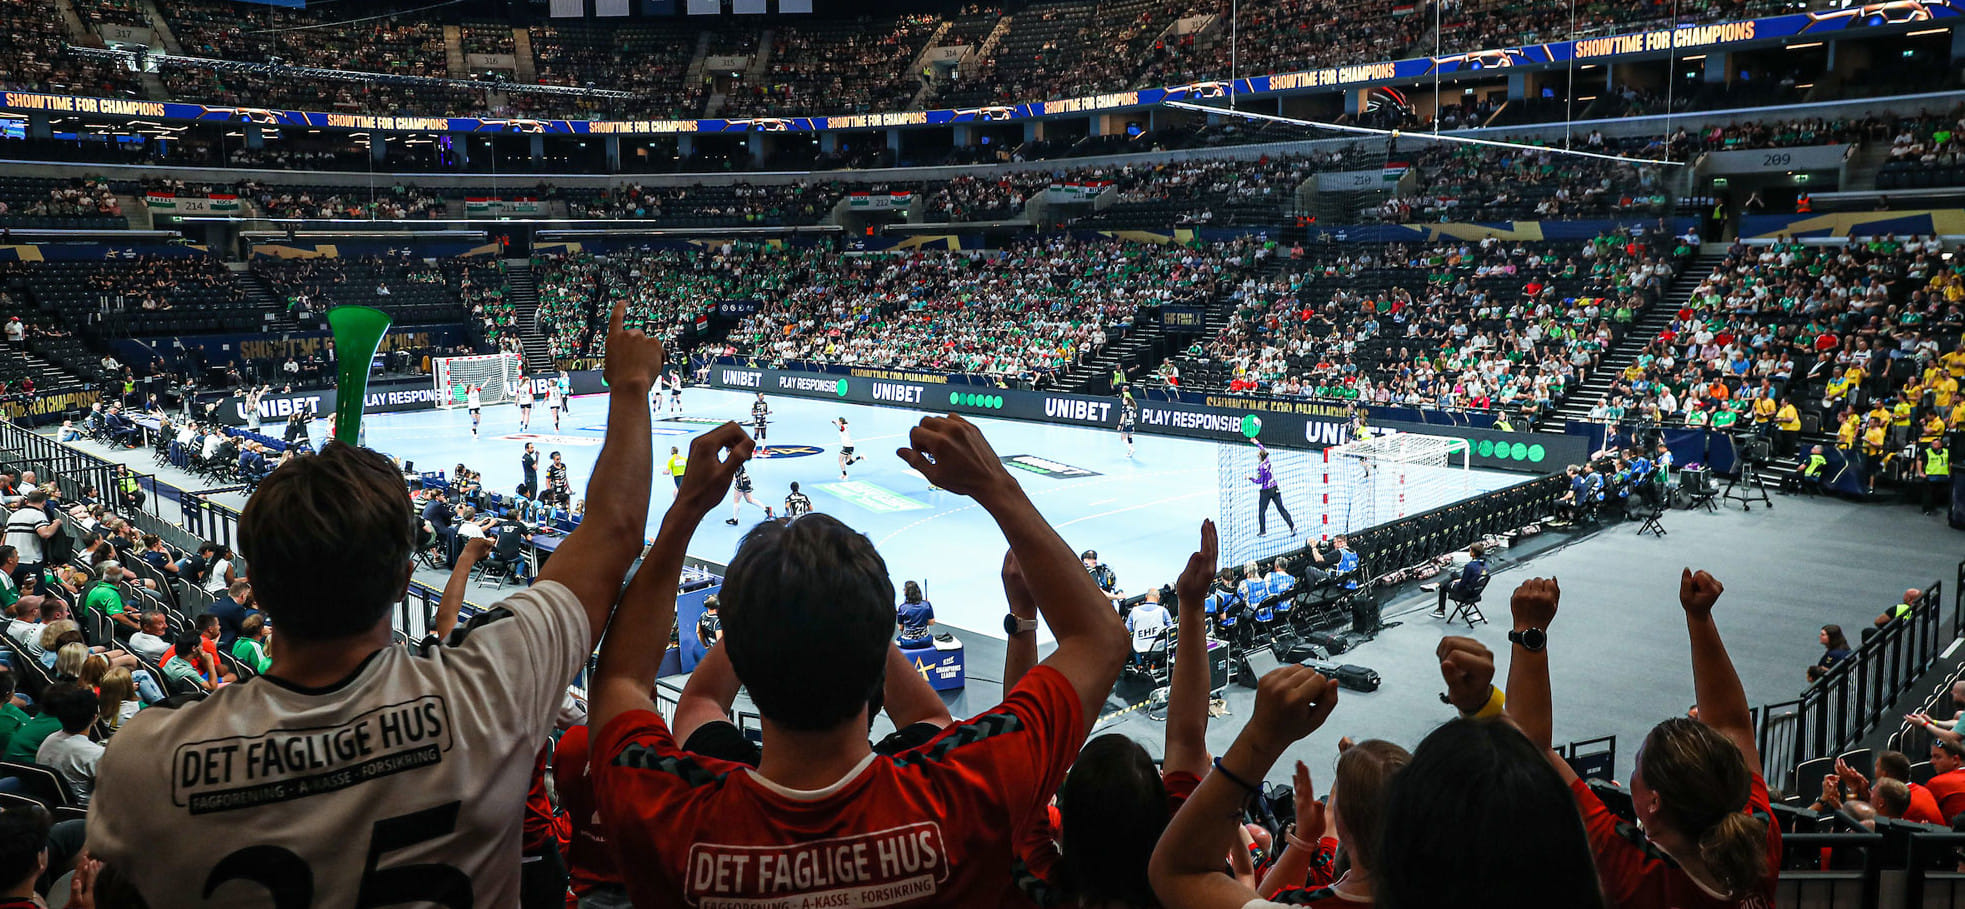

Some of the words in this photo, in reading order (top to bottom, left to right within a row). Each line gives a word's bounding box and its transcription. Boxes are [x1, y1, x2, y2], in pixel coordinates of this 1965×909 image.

[115, 29, 132, 38] 317
[1575, 33, 1643, 58] SHOWTIME
[1645, 30, 1671, 51] FOR
[1673, 21, 1756, 48] CHAMPIONS
[1268, 71, 1318, 90] SHOWTIME
[1319, 68, 1337, 86] FOR
[1338, 62, 1396, 83] CHAMPIONS
[5, 92, 74, 111] SHOWTIME
[75, 97, 98, 113] FOR
[99, 99, 165, 117] CHAMPIONS
[1044, 98, 1081, 114] SHOWTIME
[1081, 96, 1095, 111] FOR
[1096, 91, 1139, 109] CHAMPIONS
[327, 114, 376, 128] SHOWTIME
[377, 117, 394, 130] FOR
[395, 118, 449, 131] CHAMPIONS
[588, 120, 634, 134] SHOWTIME
[634, 121, 650, 133] FOR
[651, 120, 698, 133] CHAMPIONS
[827, 115, 867, 129] SHOWTIME
[868, 114, 882, 127] FOR
[883, 111, 927, 126] CHAMPIONS
[1763, 153, 1791, 167] 209
[1353, 175, 1372, 186] 210
[185, 201, 204, 211] 214
[375, 331, 430, 353] AMIONS
[722, 369, 763, 388] UNIBET
[779, 375, 799, 390] PLAY
[797, 377, 839, 394] RESPONSIB
[364, 392, 387, 407] LAY
[872, 382, 924, 404] UNIBET
[236, 395, 321, 420] UNIBET
[1045, 397, 1111, 422] UNIBET
[1141, 408, 1172, 426] PLAY
[1172, 411, 1245, 433] RESPONSIB
[795, 502, 805, 515] 21
[1137, 626, 1158, 638] EHF
[181, 744, 241, 788] DET
[247, 720, 372, 780] FAGLIGE
[379, 701, 443, 749] HUS
[191, 785, 285, 811] FAGFORENING
[361, 748, 438, 778] FORSIKRING
[693, 851, 751, 894] DET
[758, 842, 872, 894] FAGLIGE
[877, 830, 938, 878] HUS
[802, 892, 850, 909] A-KASSE
[861, 878, 932, 905] FORSIKRING
